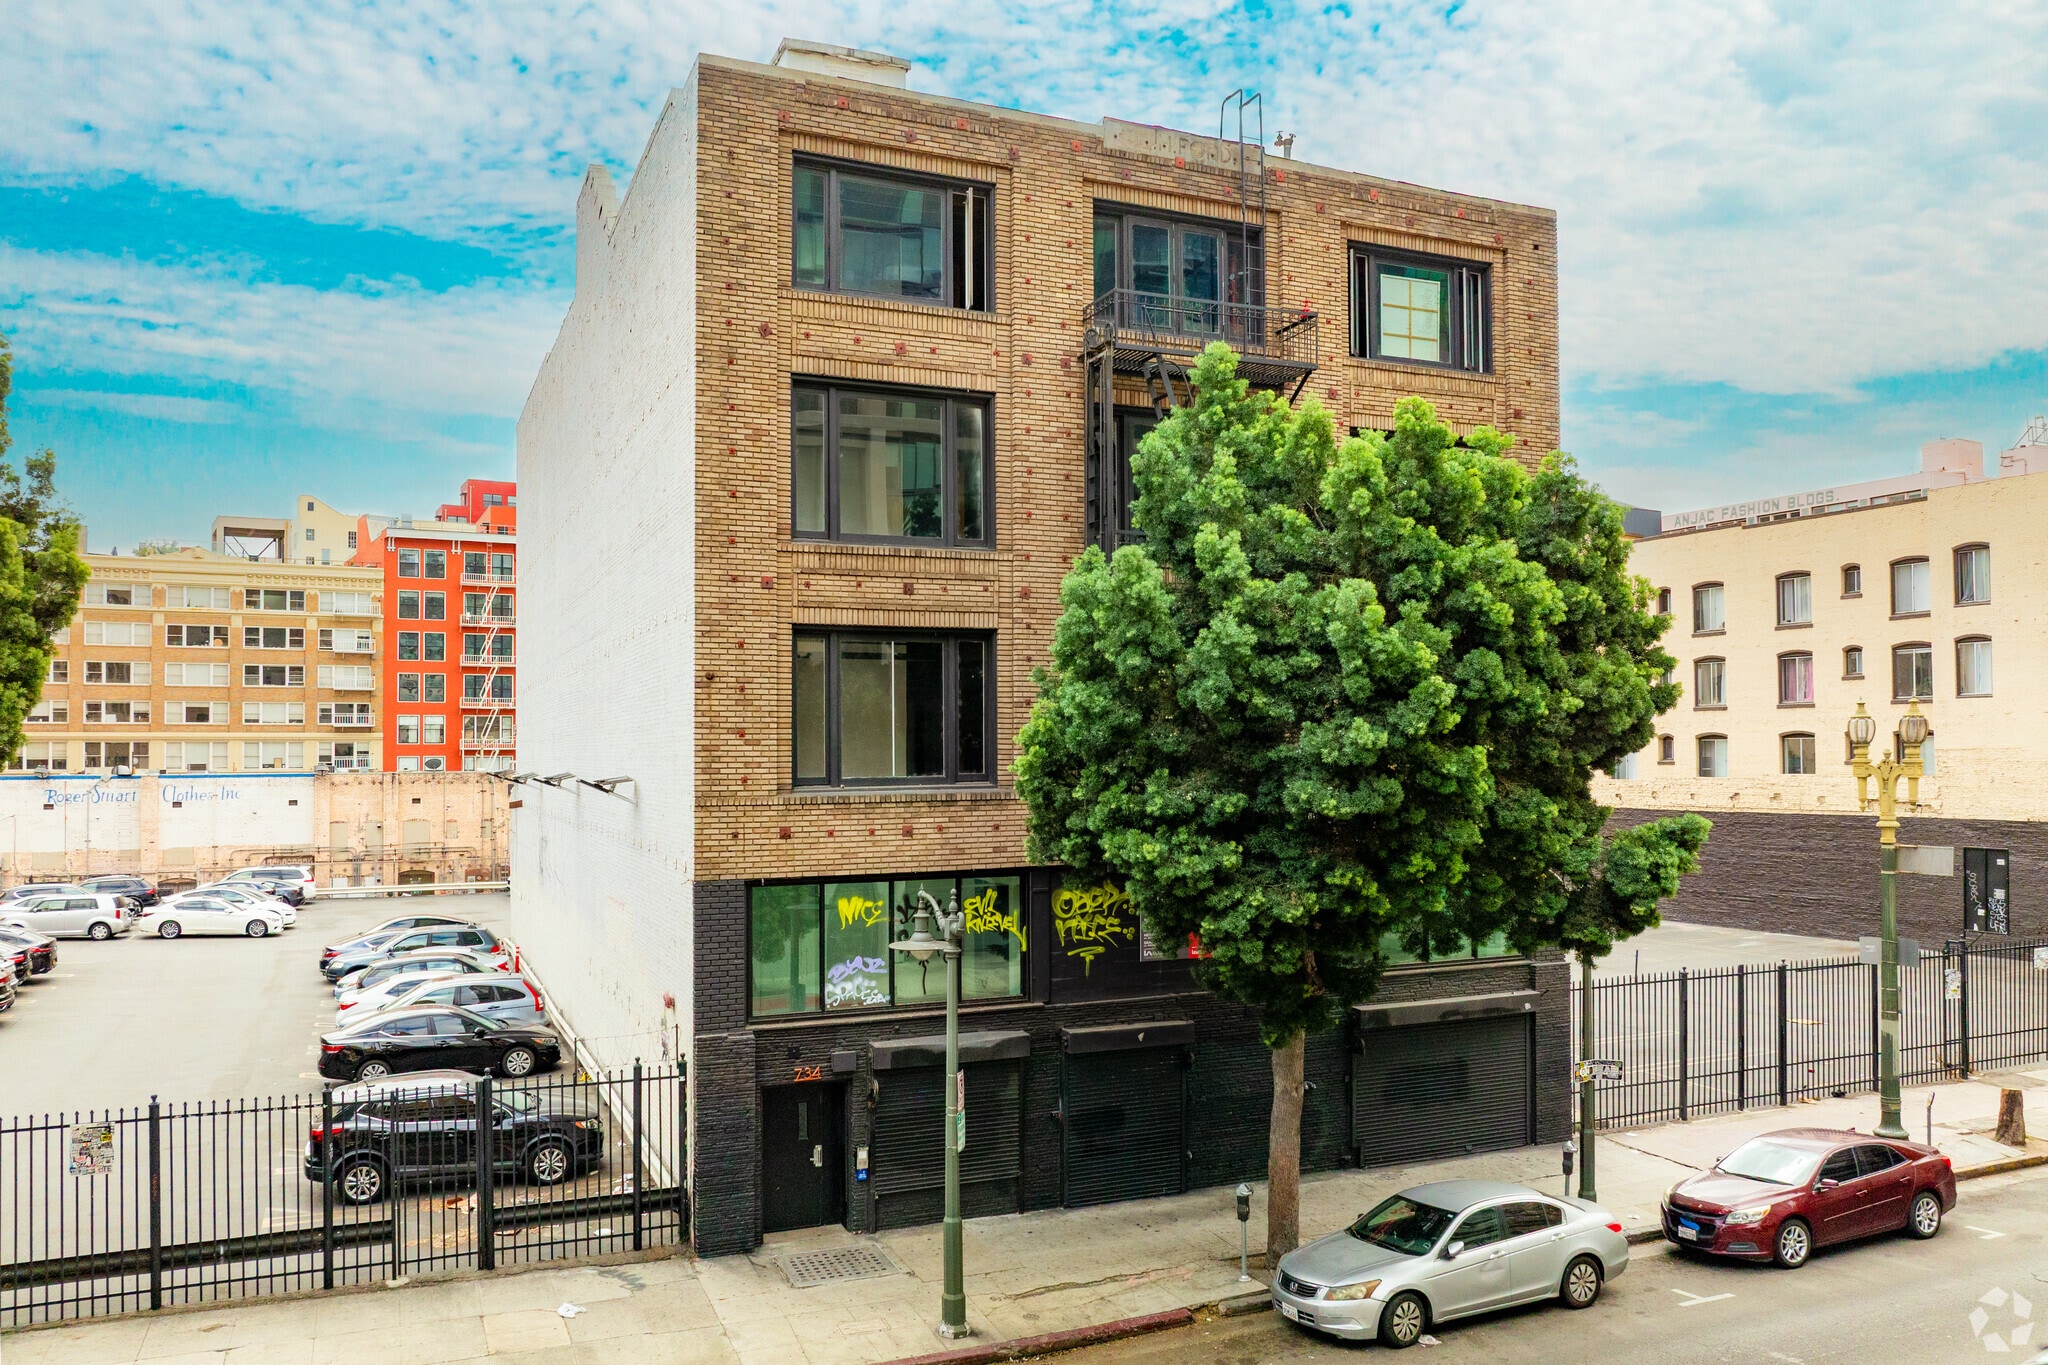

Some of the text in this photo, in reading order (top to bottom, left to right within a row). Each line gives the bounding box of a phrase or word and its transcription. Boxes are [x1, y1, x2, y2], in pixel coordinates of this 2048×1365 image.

[1674, 510, 1715, 527] ANJAC
[1721, 500, 1780, 518] FASHION
[44, 789, 88, 807] Roger
[91, 784, 136, 804] Stuart
[162, 784, 213, 803] Clothes
[793, 1066, 823, 1083] 734
